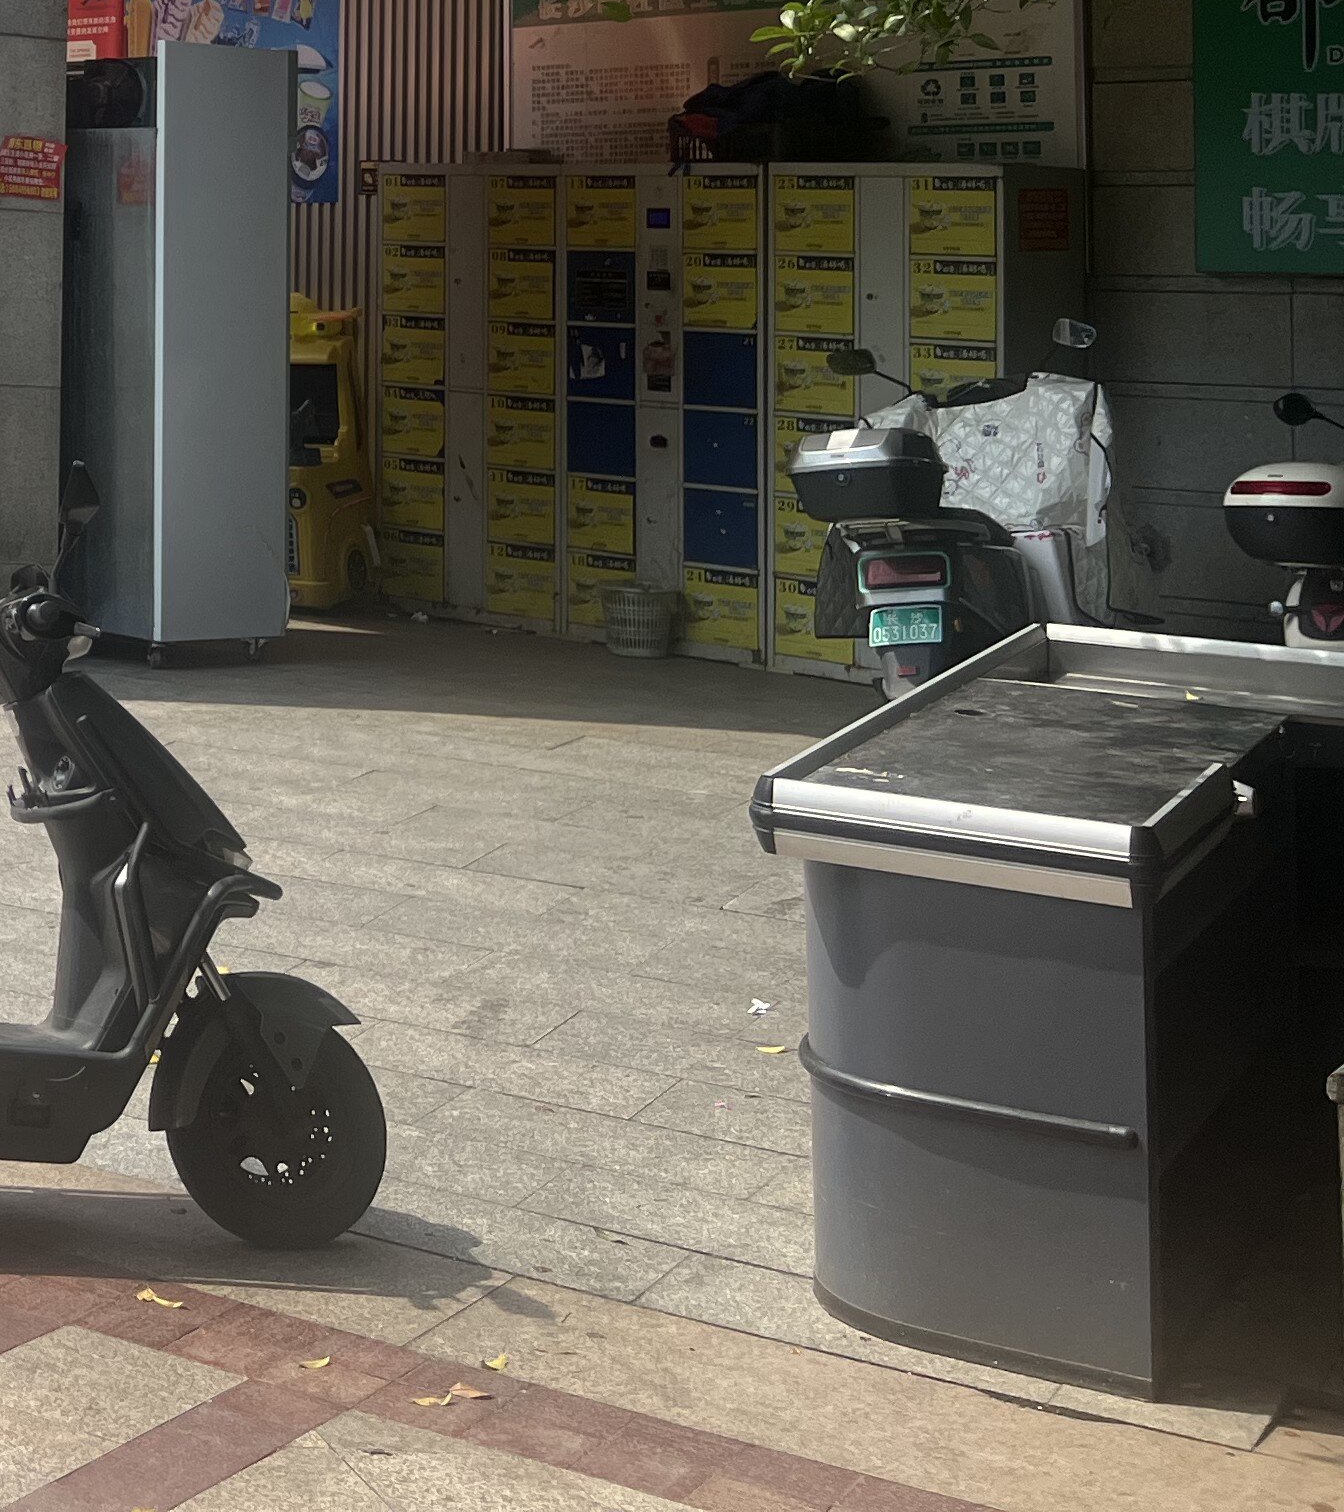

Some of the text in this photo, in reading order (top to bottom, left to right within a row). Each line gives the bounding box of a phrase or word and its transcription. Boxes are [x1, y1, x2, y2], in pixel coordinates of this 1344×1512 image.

[777, 179, 796, 190] 25
[685, 256, 703, 267] 20
[777, 258, 796, 270] 26
[912, 261, 932, 274] 32
[777, 338, 795, 349] 27
[912, 346, 932, 358] 33
[777, 420, 795, 431] 28
[777, 500, 795, 511] 29
[778, 582, 796, 593] 30
[873, 623, 938, 643] 0531037
